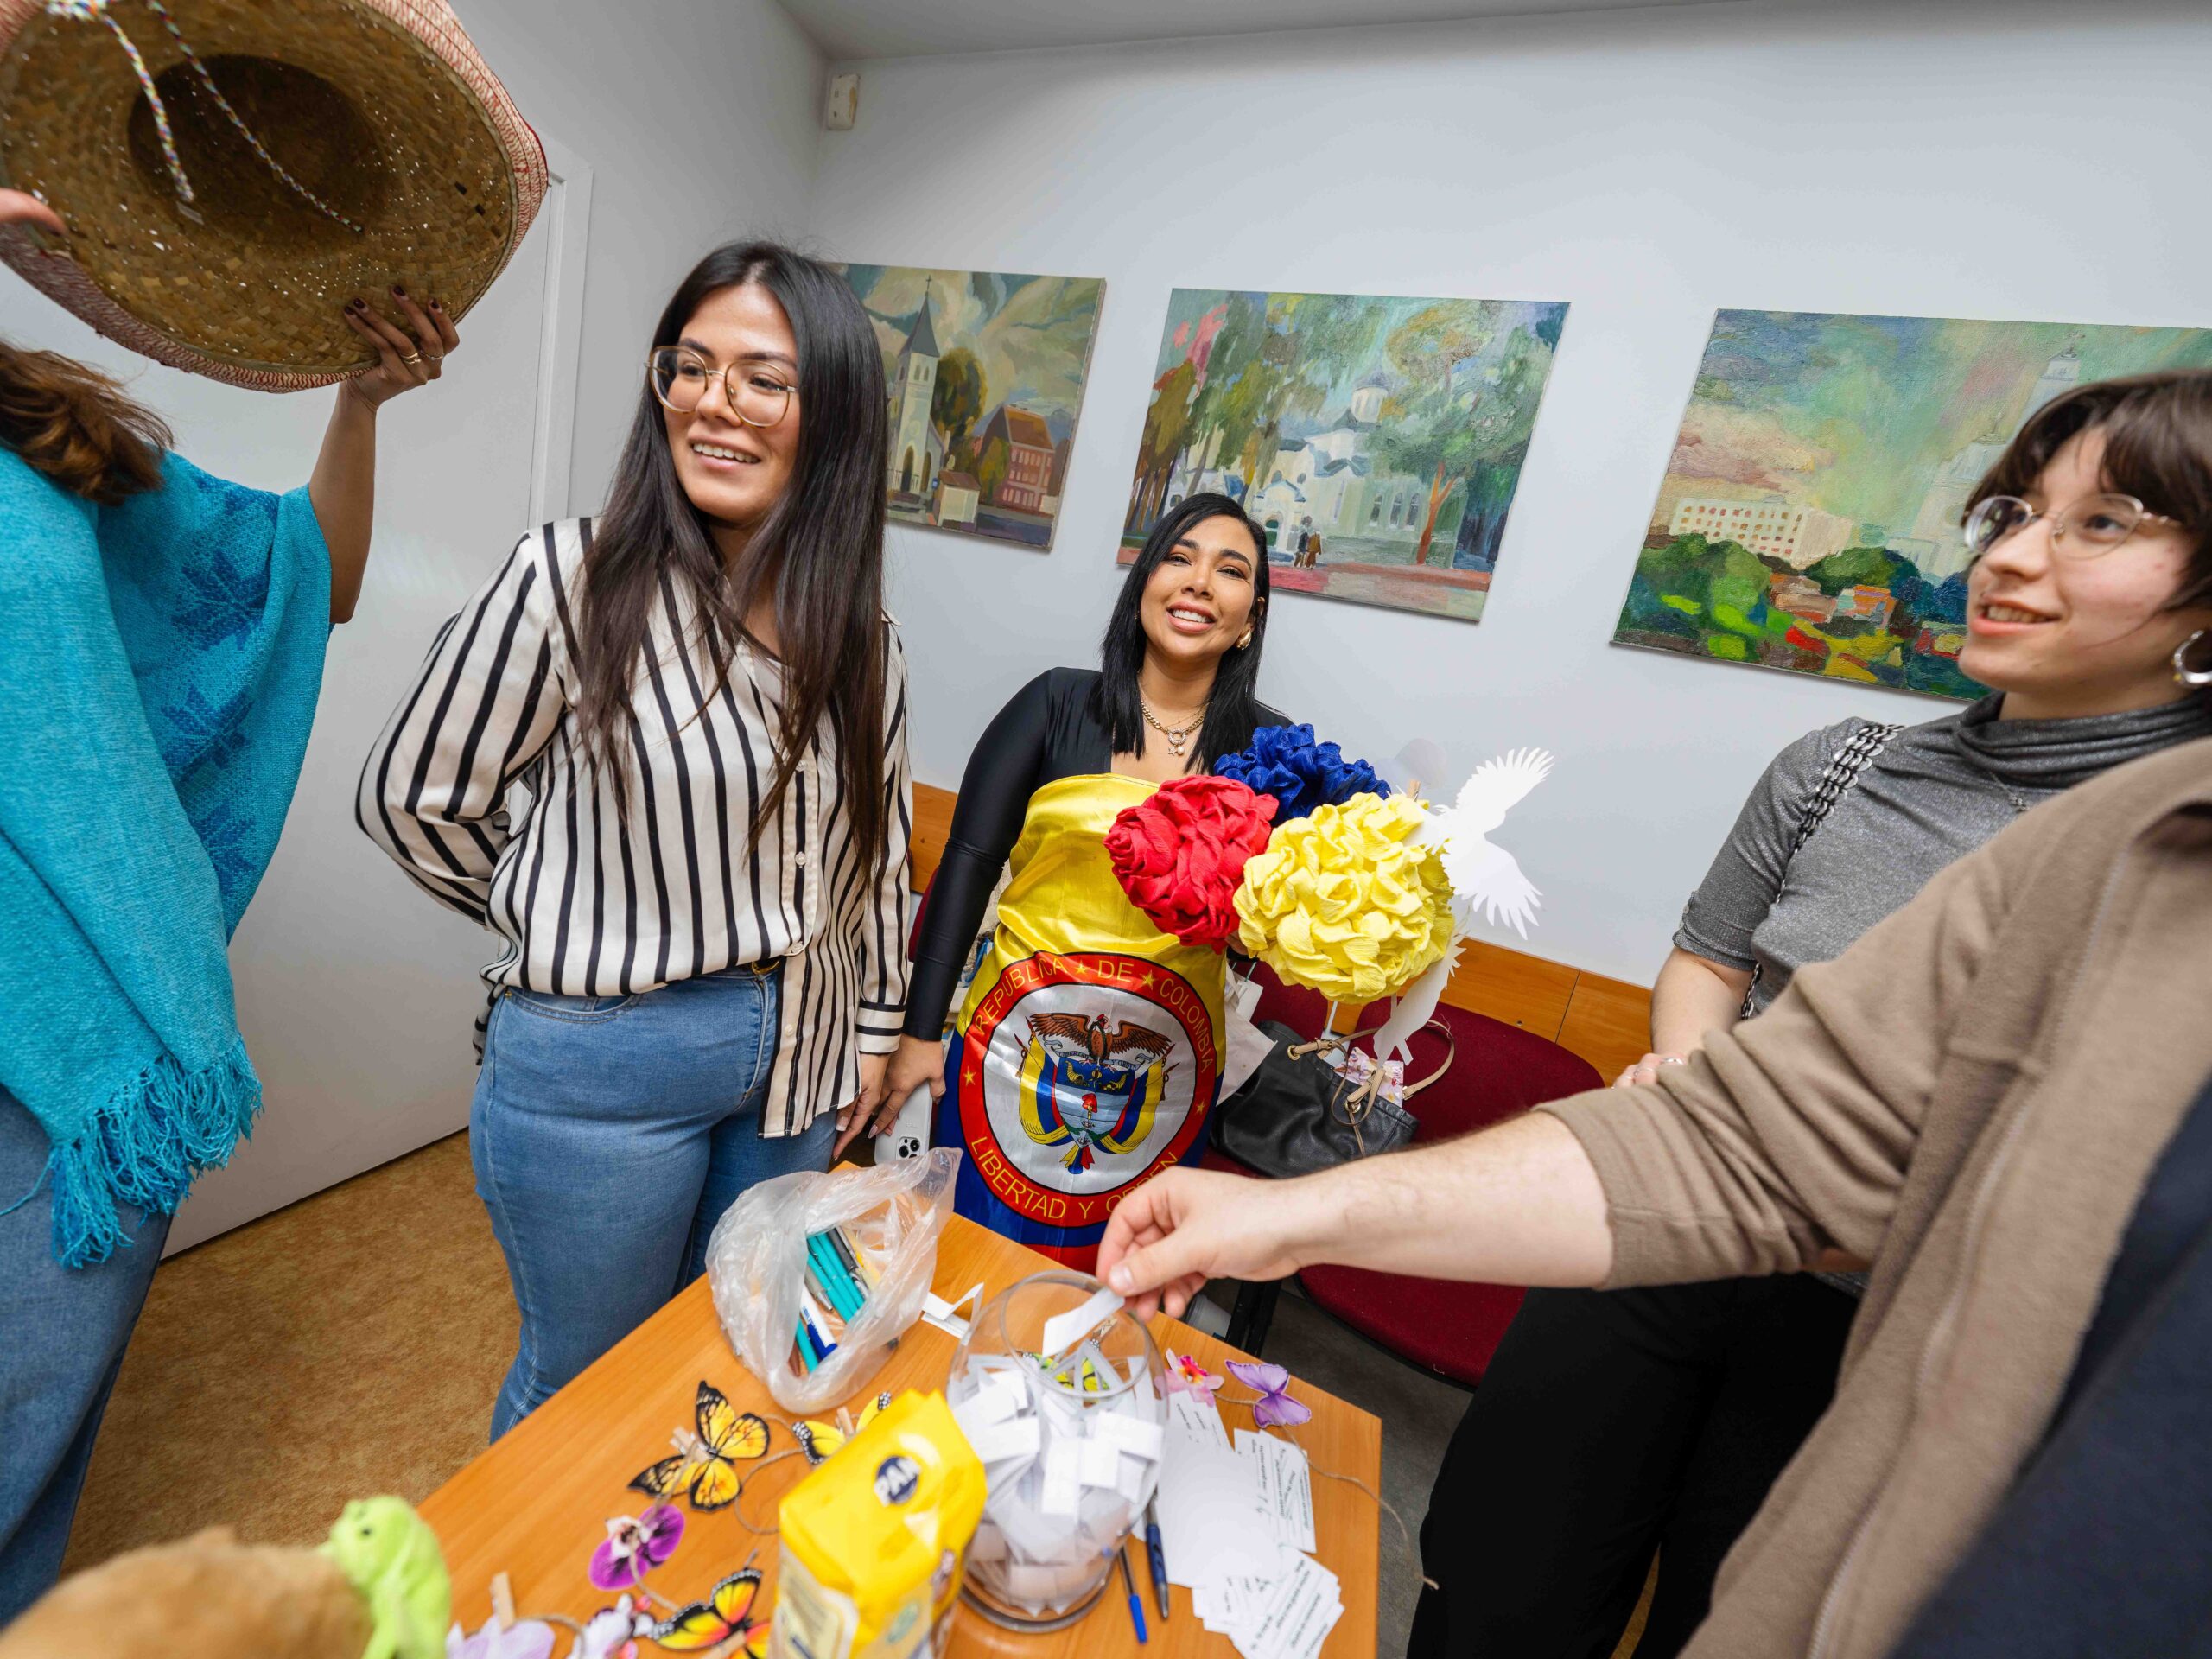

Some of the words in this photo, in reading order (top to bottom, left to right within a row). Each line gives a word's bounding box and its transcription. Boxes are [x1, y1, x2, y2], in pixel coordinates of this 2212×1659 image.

[975, 957, 1068, 1036] REPUBLICA
[1097, 959, 1135, 982] DE
[1160, 978, 1213, 1074] COLOMBIA
[971, 1136, 1066, 1219] LIBERTAD
[1078, 1201, 1095, 1220] Y
